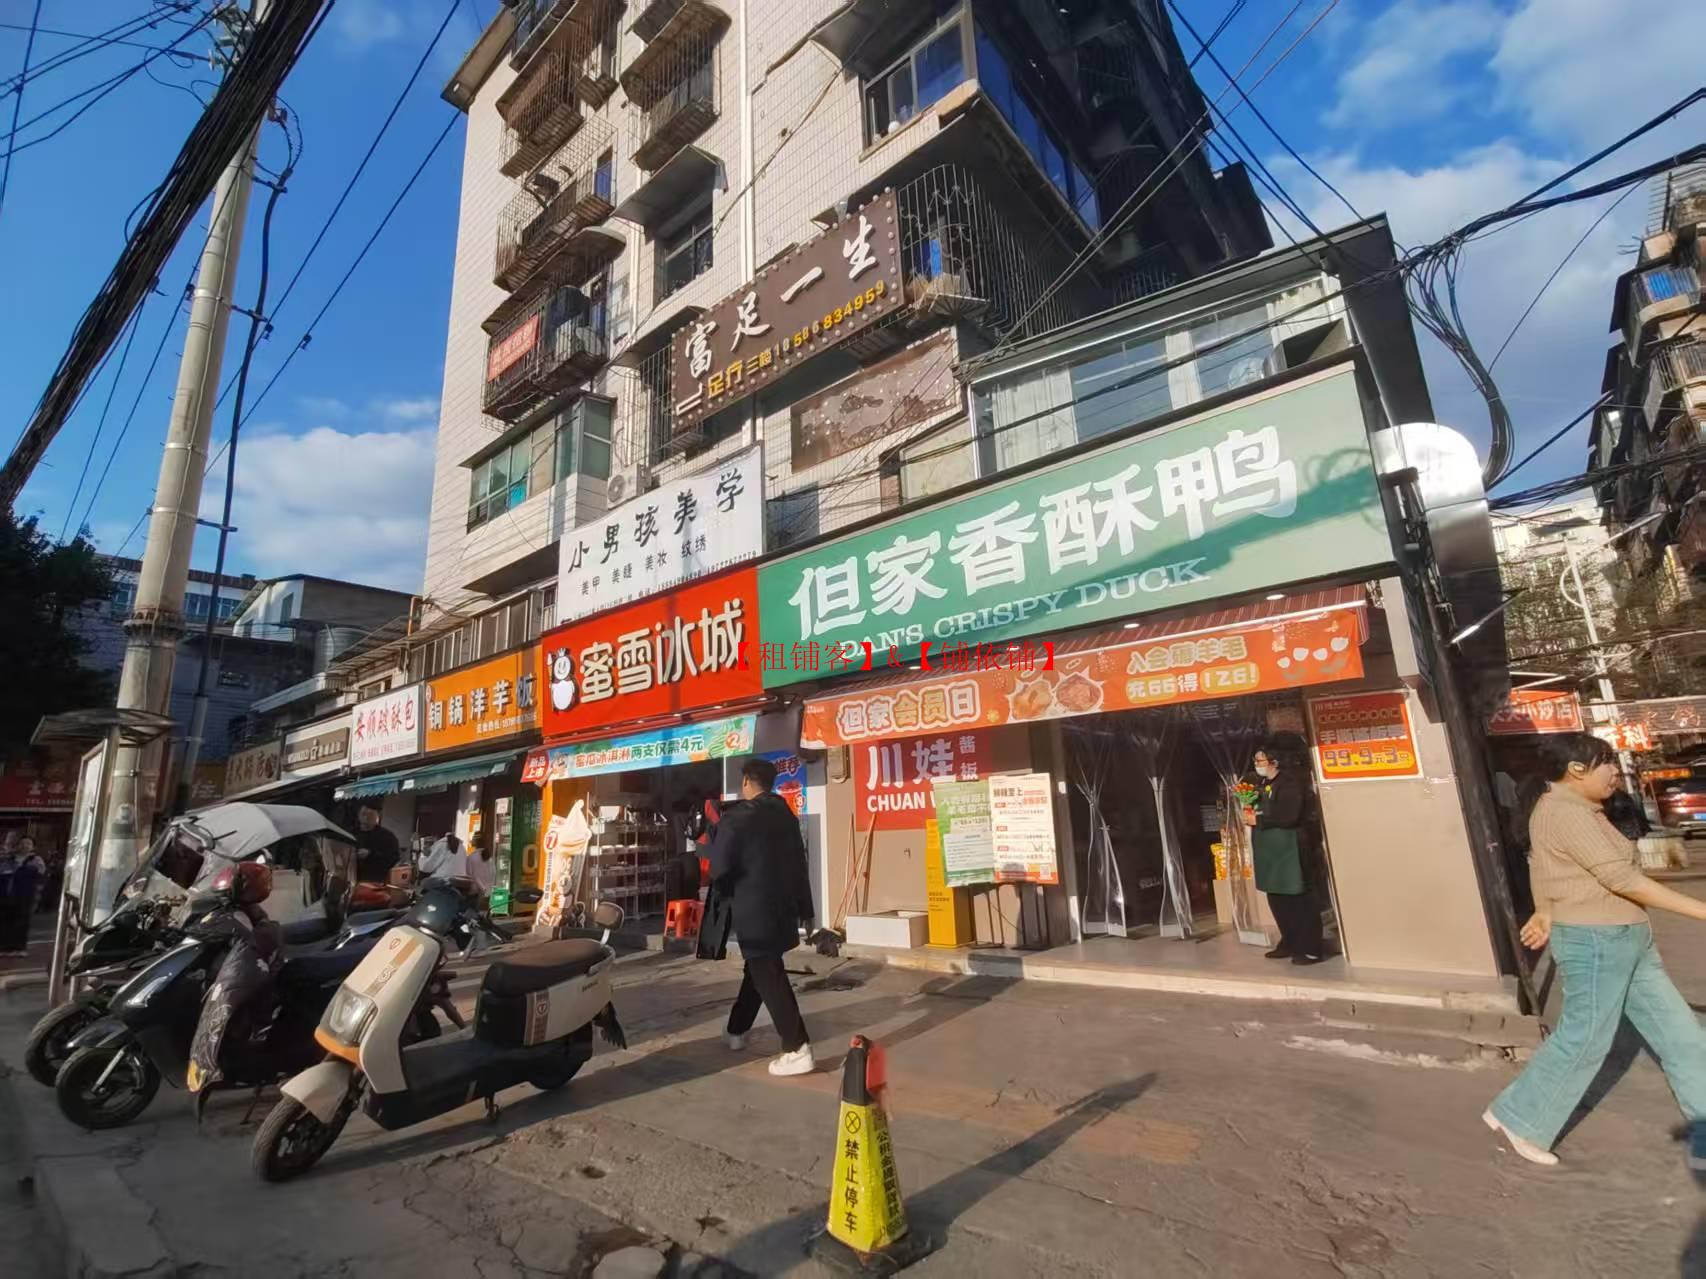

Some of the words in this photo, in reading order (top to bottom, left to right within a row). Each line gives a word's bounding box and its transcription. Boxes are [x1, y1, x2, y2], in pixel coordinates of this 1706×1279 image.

[567, 467, 744, 573] 小男孩美学
[788, 426, 1297, 641] 但家香酥鸭
[933, 589, 1068, 638] CRISPY
[1076, 557, 1211, 608] DUCK
[580, 598, 743, 704] 蜜雪冰城
[430, 672, 536, 730] 铜锅洋芋饭
[837, 683, 979, 738] 但家会员日
[866, 738, 955, 791] 川娃
[866, 791, 926, 812] CHUAN
[844, 1139, 860, 1233] 禁止停车
